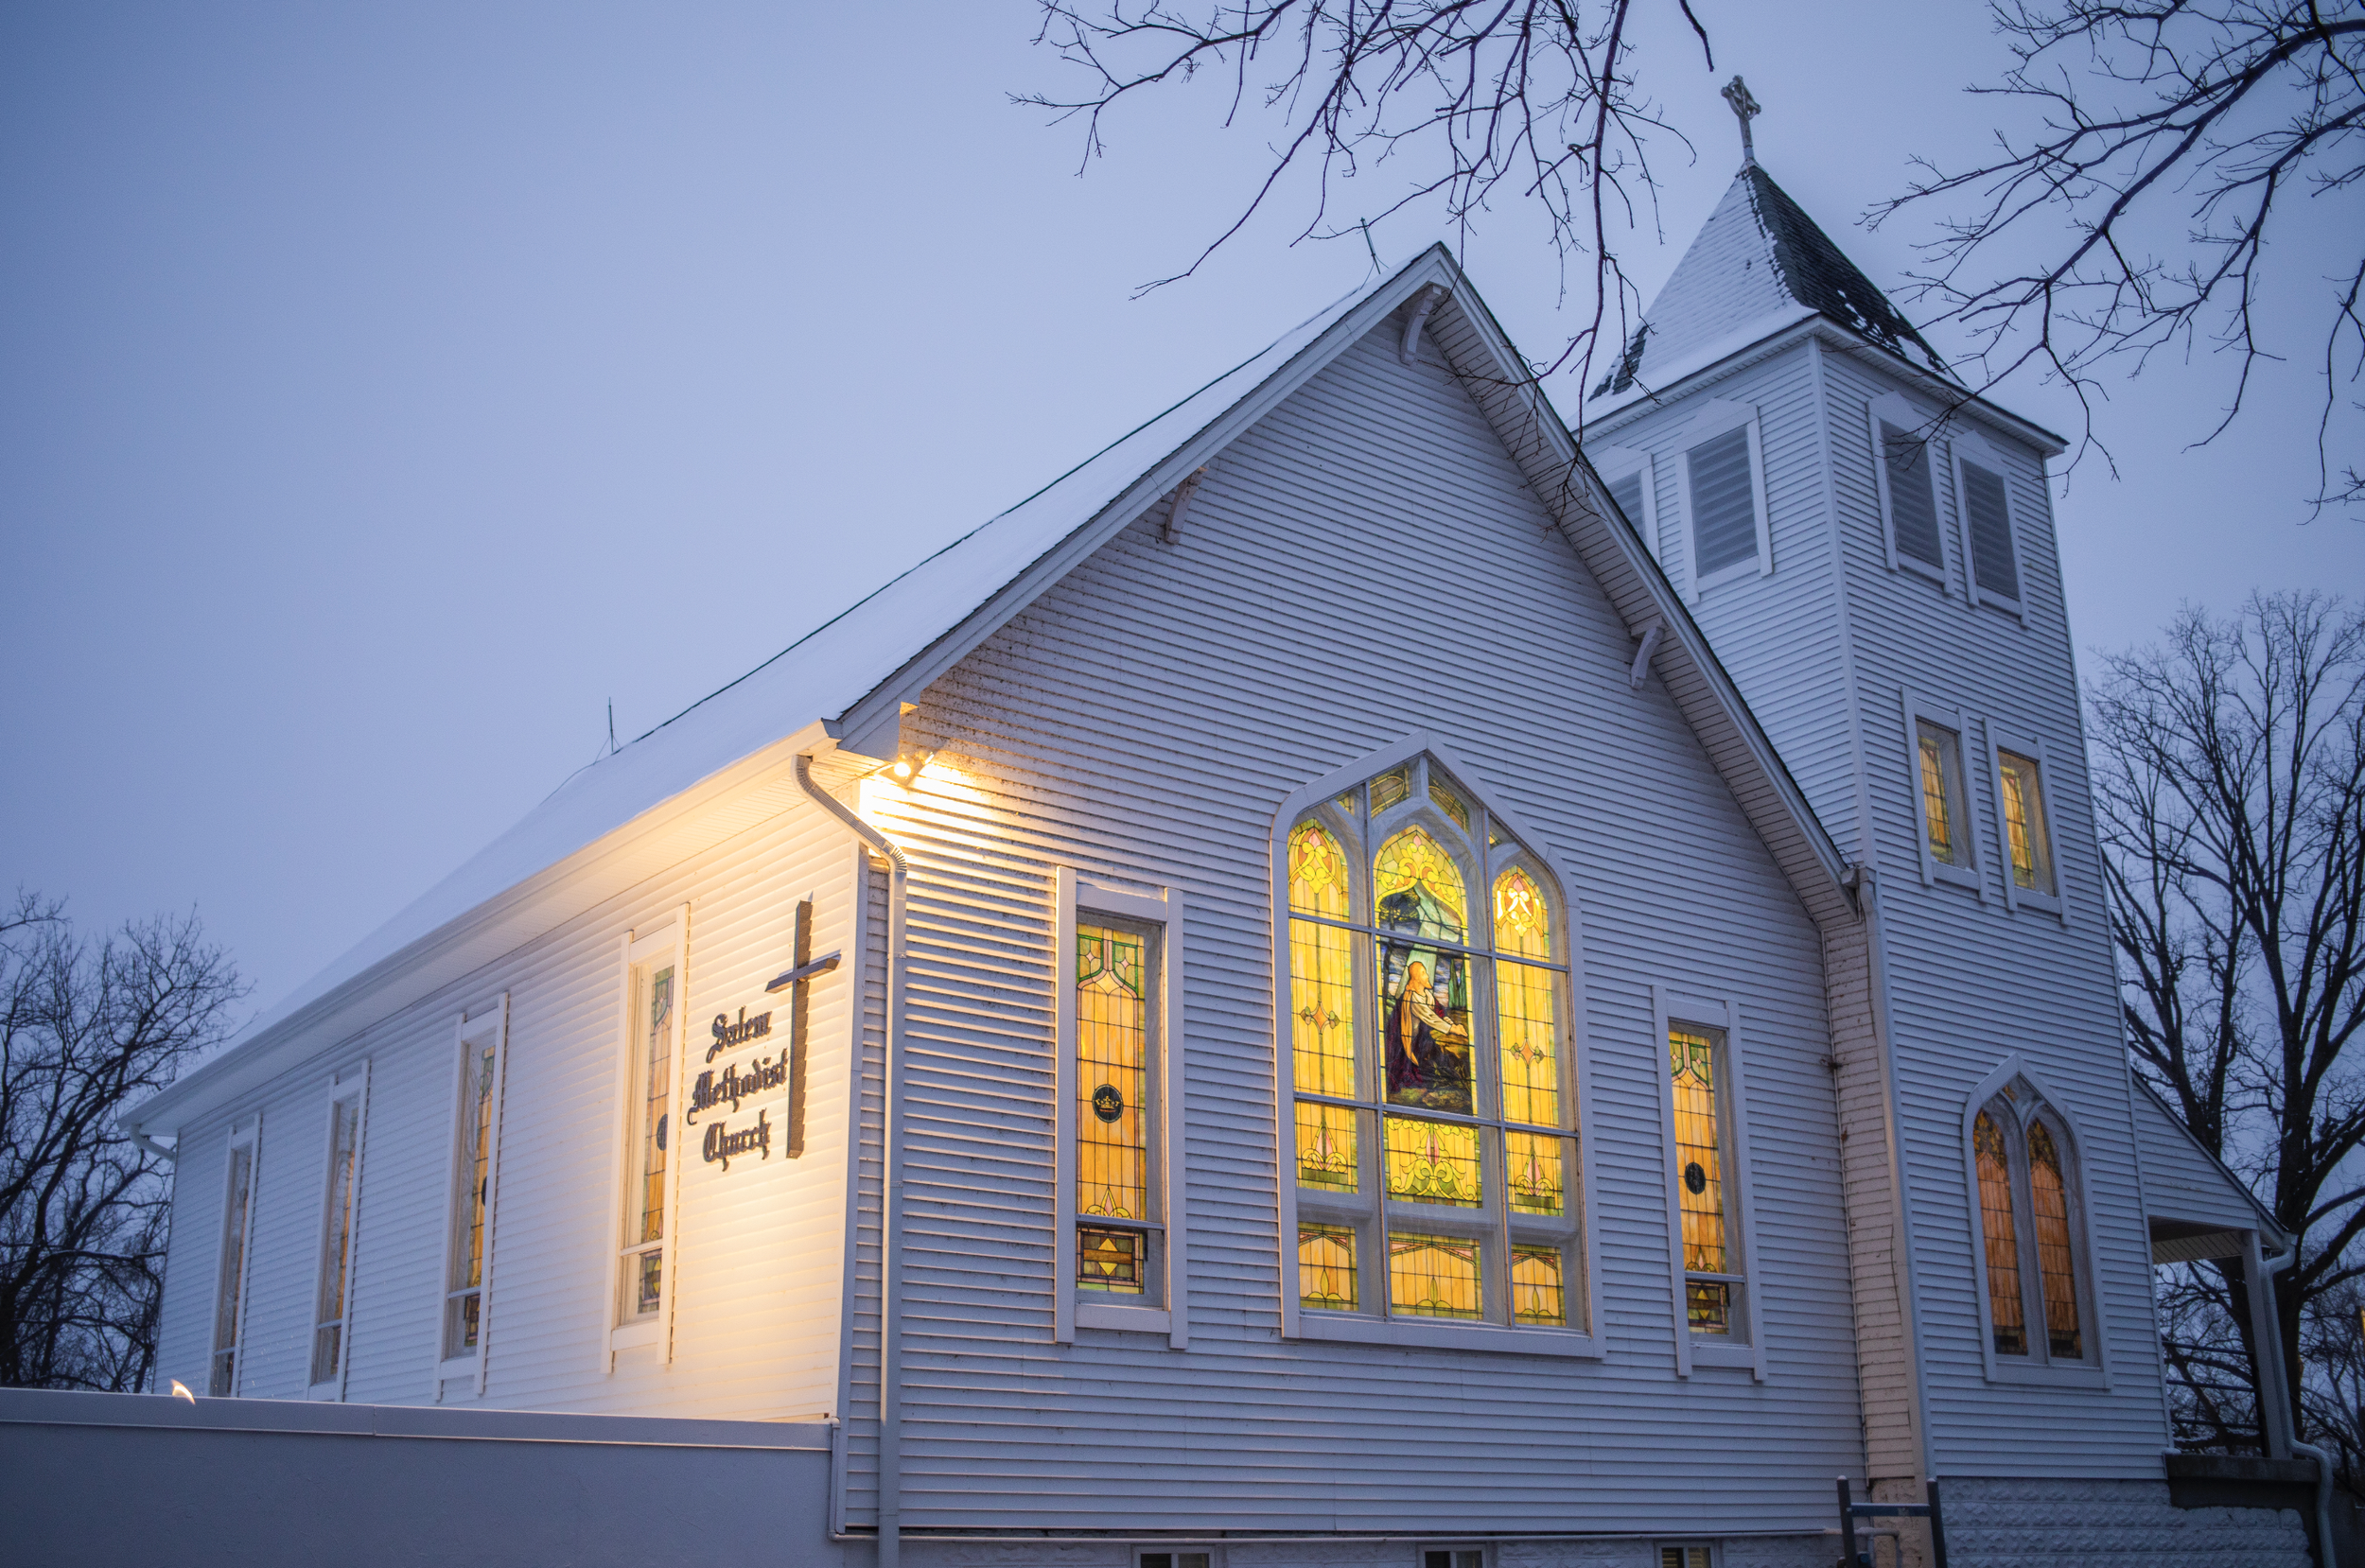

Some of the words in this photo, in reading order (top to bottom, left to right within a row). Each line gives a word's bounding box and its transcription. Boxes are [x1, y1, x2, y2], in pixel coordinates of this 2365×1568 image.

[707, 1006, 772, 1063] Salem
[688, 1048, 789, 1125] Methodist
[703, 1108, 771, 1172] Church
